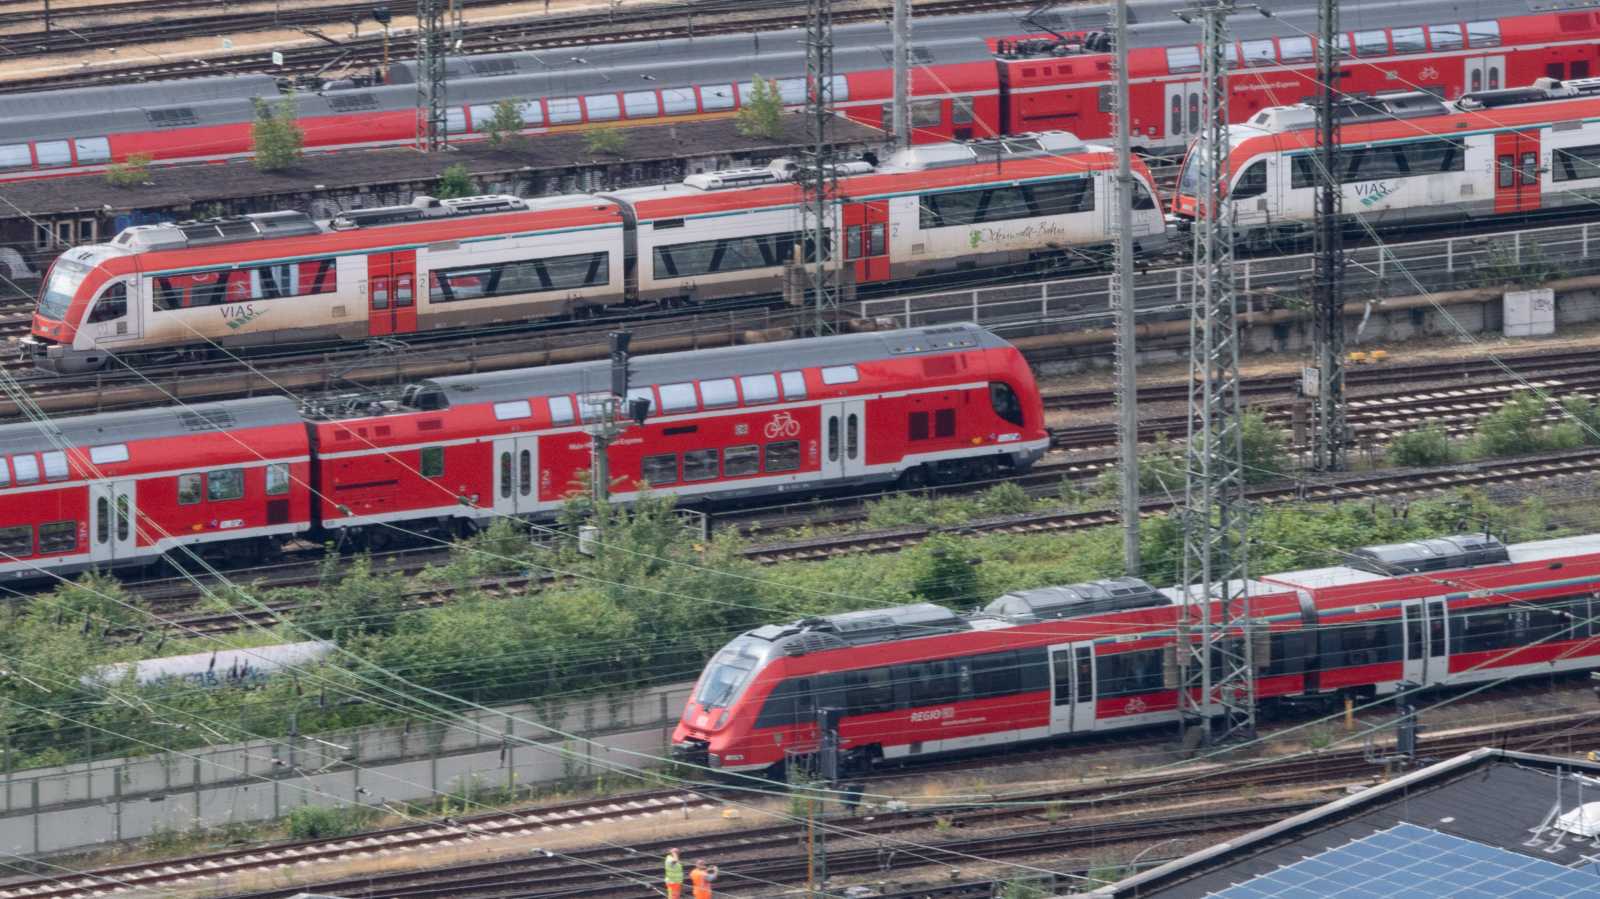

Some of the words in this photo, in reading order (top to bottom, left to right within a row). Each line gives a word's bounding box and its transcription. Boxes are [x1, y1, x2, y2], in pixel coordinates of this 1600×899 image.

[1486, 164, 1492, 174] 2
[1355, 181, 1387, 196] VIAS
[892, 227, 898, 238] 2
[420, 278, 426, 288] 2
[220, 304, 254, 318] VIAS
[809, 440, 817, 451] 2
[542, 470, 550, 481] 2
[911, 709, 941, 722] REGIO
